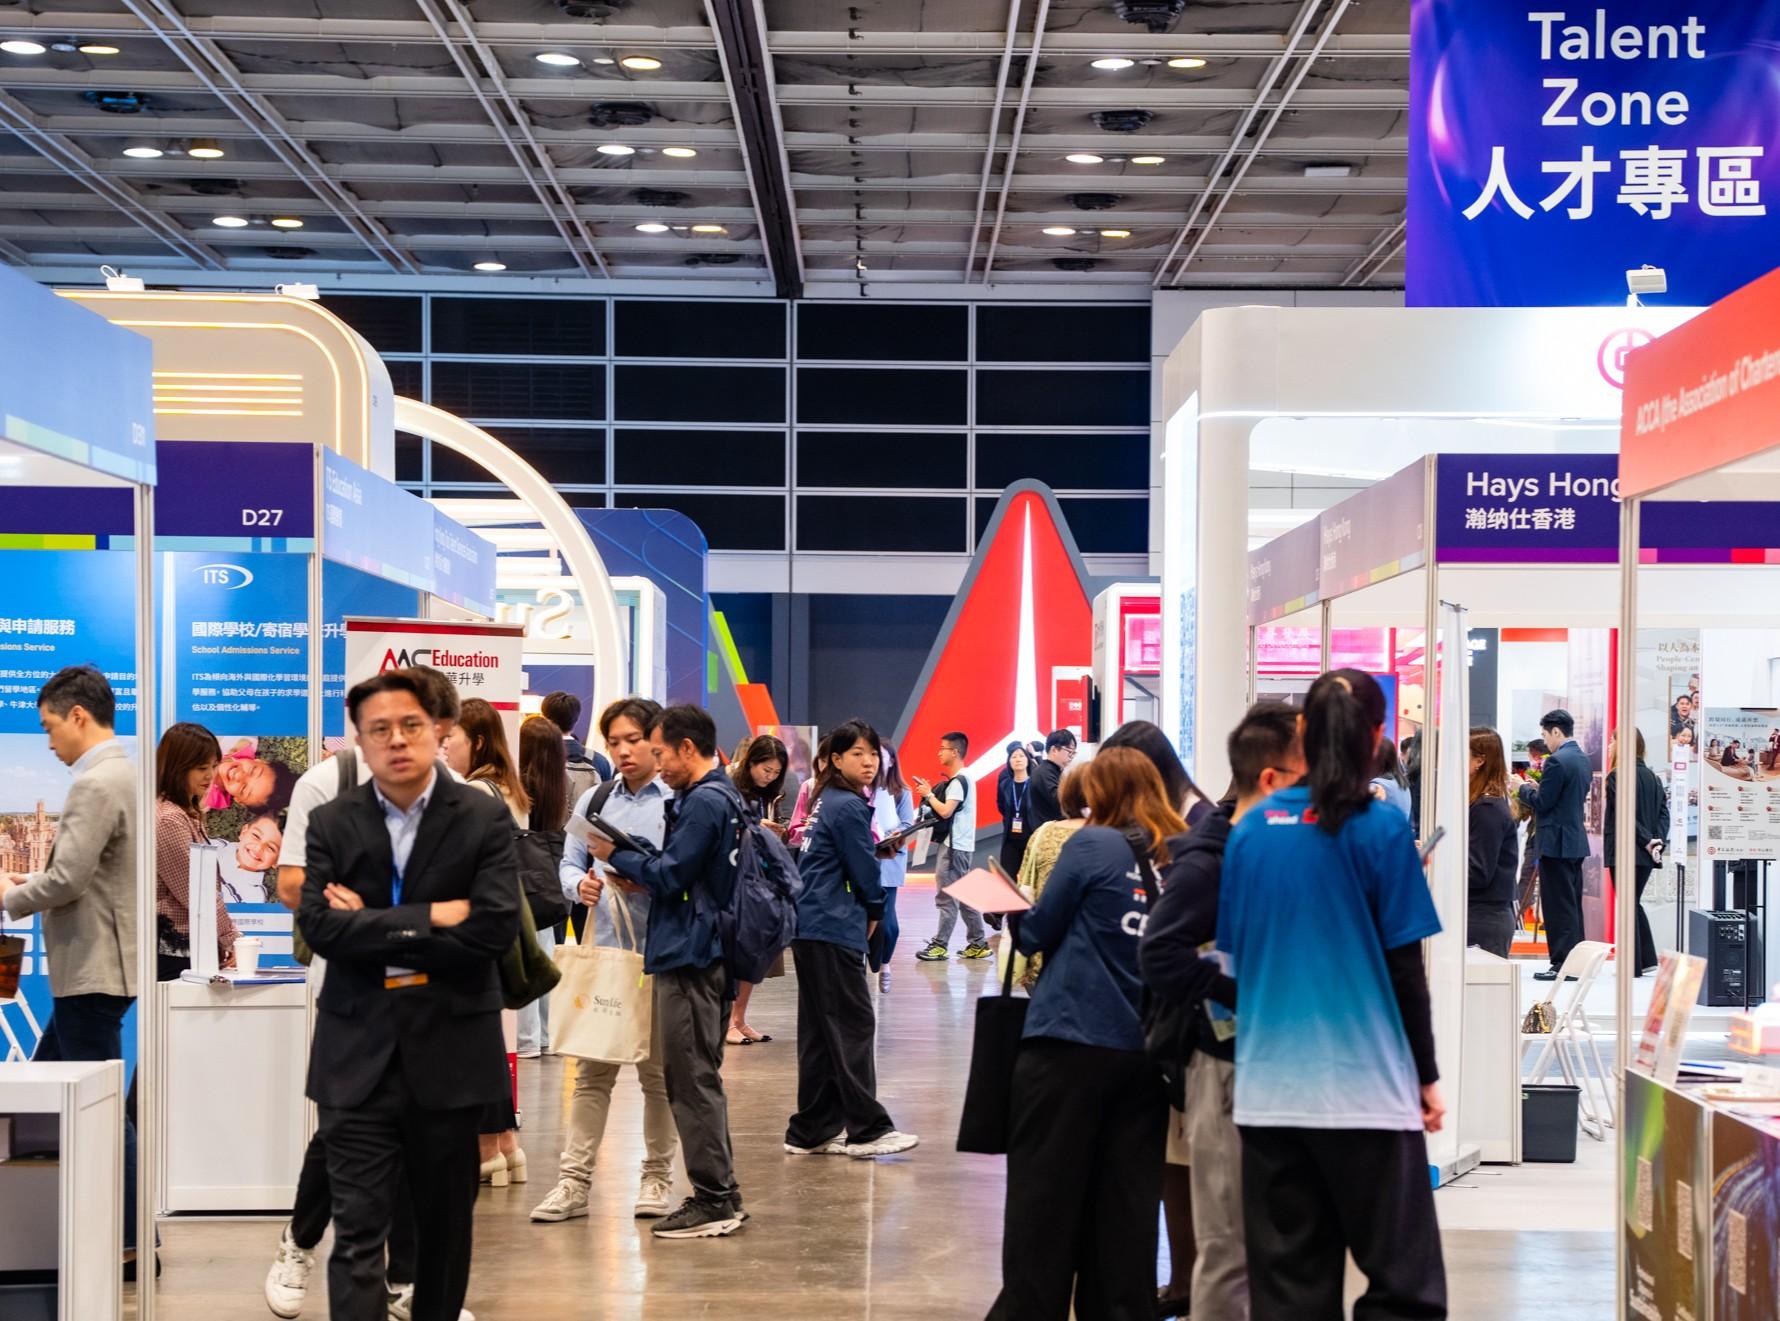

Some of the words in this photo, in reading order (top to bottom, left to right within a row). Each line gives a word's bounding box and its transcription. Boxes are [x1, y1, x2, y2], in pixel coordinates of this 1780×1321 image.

[1528, 9, 1706, 60] Talent
[1541, 78, 1690, 126] Zone
[1461, 145, 1767, 221] 人才專區
[1634, 398, 1660, 437] ACCA
[1677, 369, 1729, 419] Association
[1728, 358, 1740, 397] of
[1466, 472, 1540, 503] Hays
[241, 509, 284, 526] D27
[1465, 508, 1576, 530] 瀚纳仕香港
[203, 569, 229, 585] ITS
[0, 618, 75, 636] 與申請服務
[192, 621, 349, 638] 國際學校/寄宿學升
[23, 643, 56, 652] Service
[191, 645, 220, 654] School
[220, 646, 268, 655] Admissions
[269, 646, 301, 655] Service
[432, 649, 499, 668] Education
